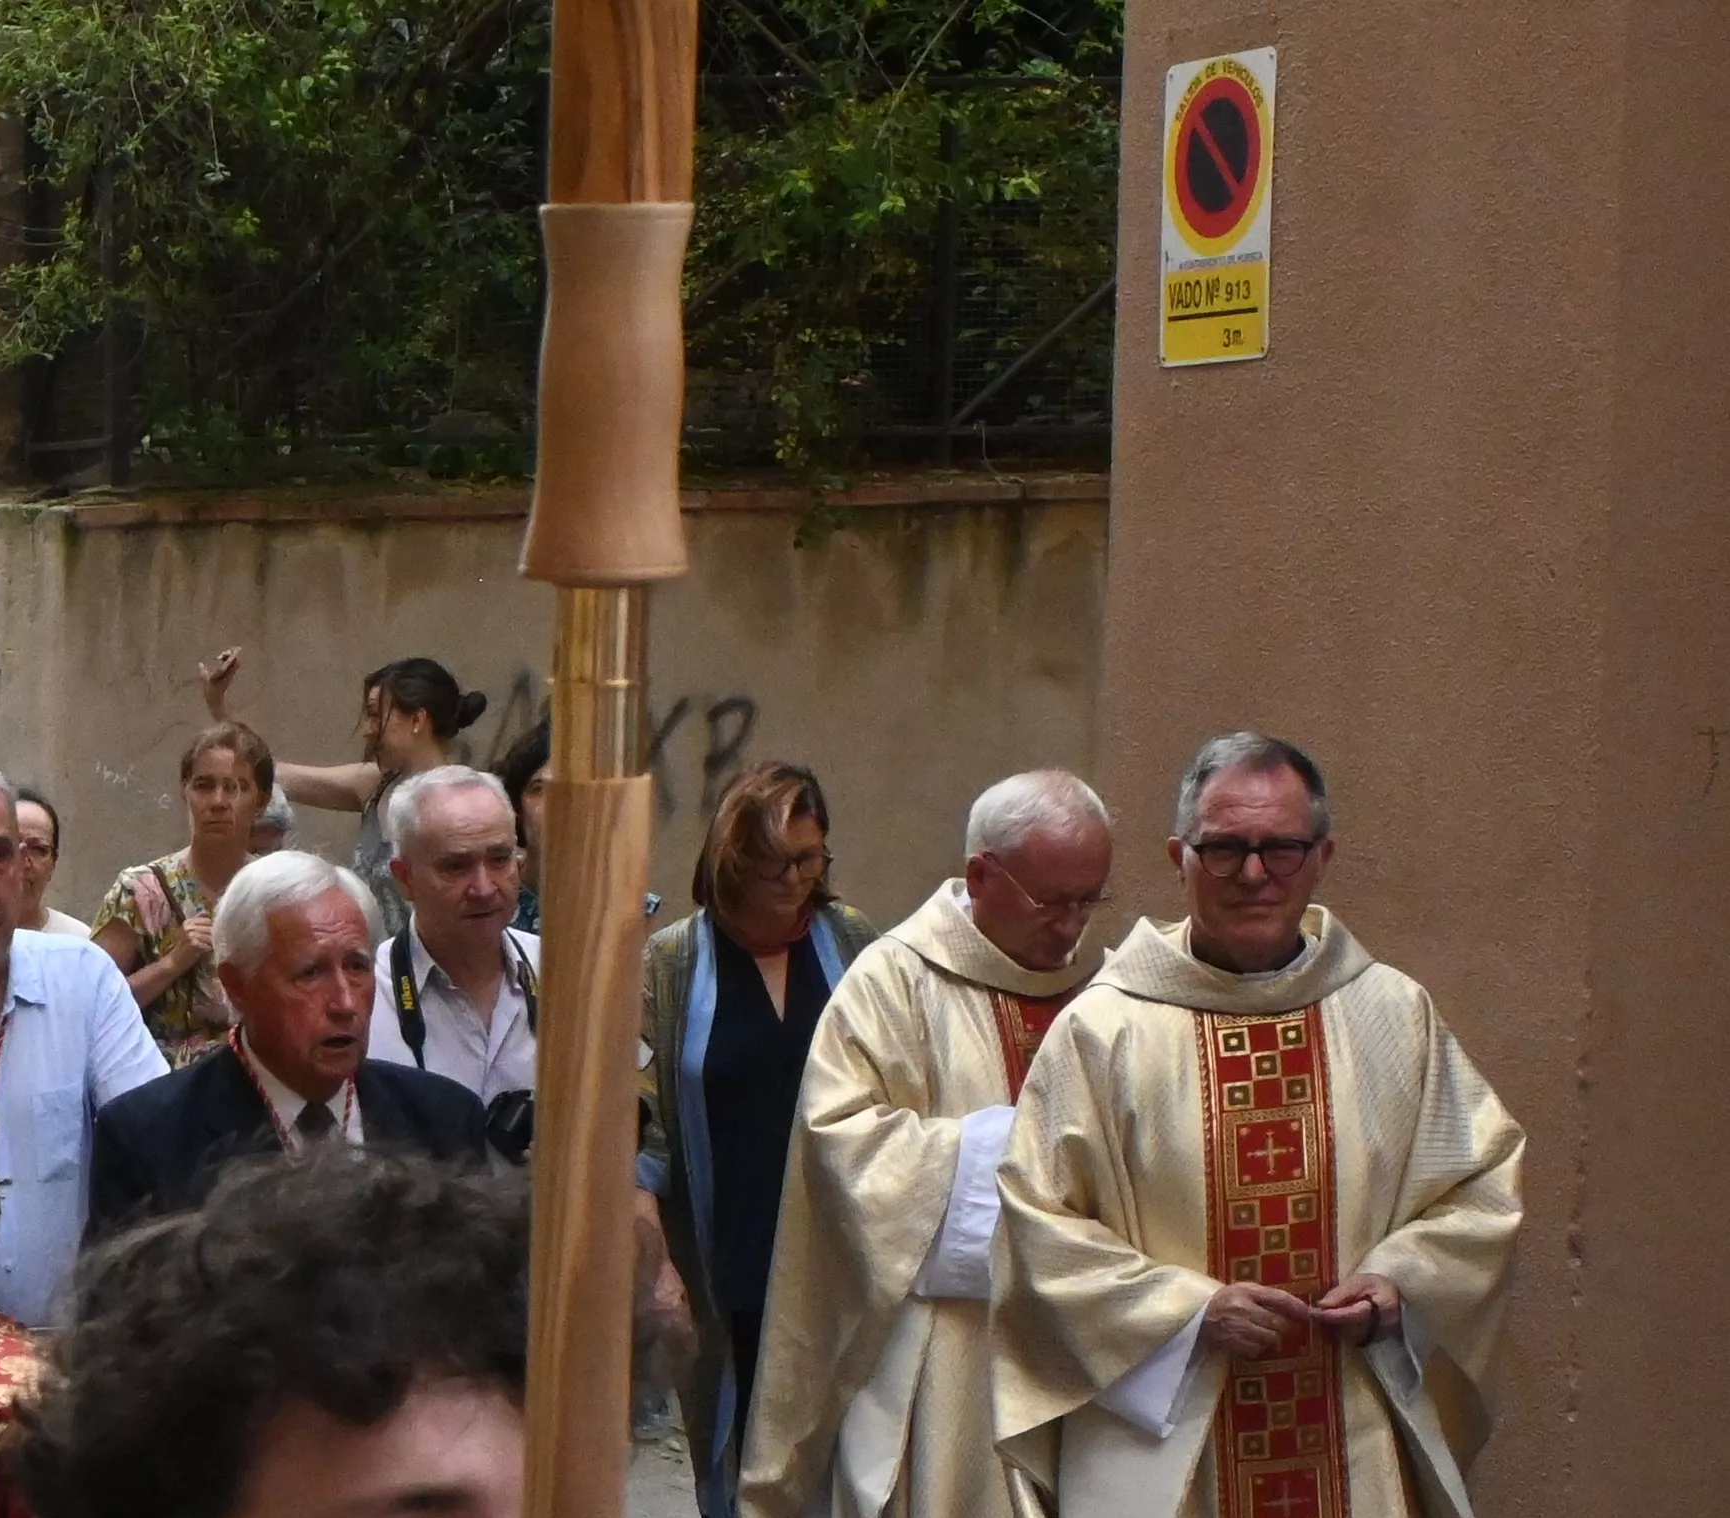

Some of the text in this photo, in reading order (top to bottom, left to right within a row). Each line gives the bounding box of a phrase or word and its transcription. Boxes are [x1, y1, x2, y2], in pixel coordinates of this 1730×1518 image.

[1205, 61, 1216, 78] DE
[1168, 279, 1203, 311] VADO
[1225, 280, 1251, 302] 913
[401, 975, 415, 1010] Nikon
